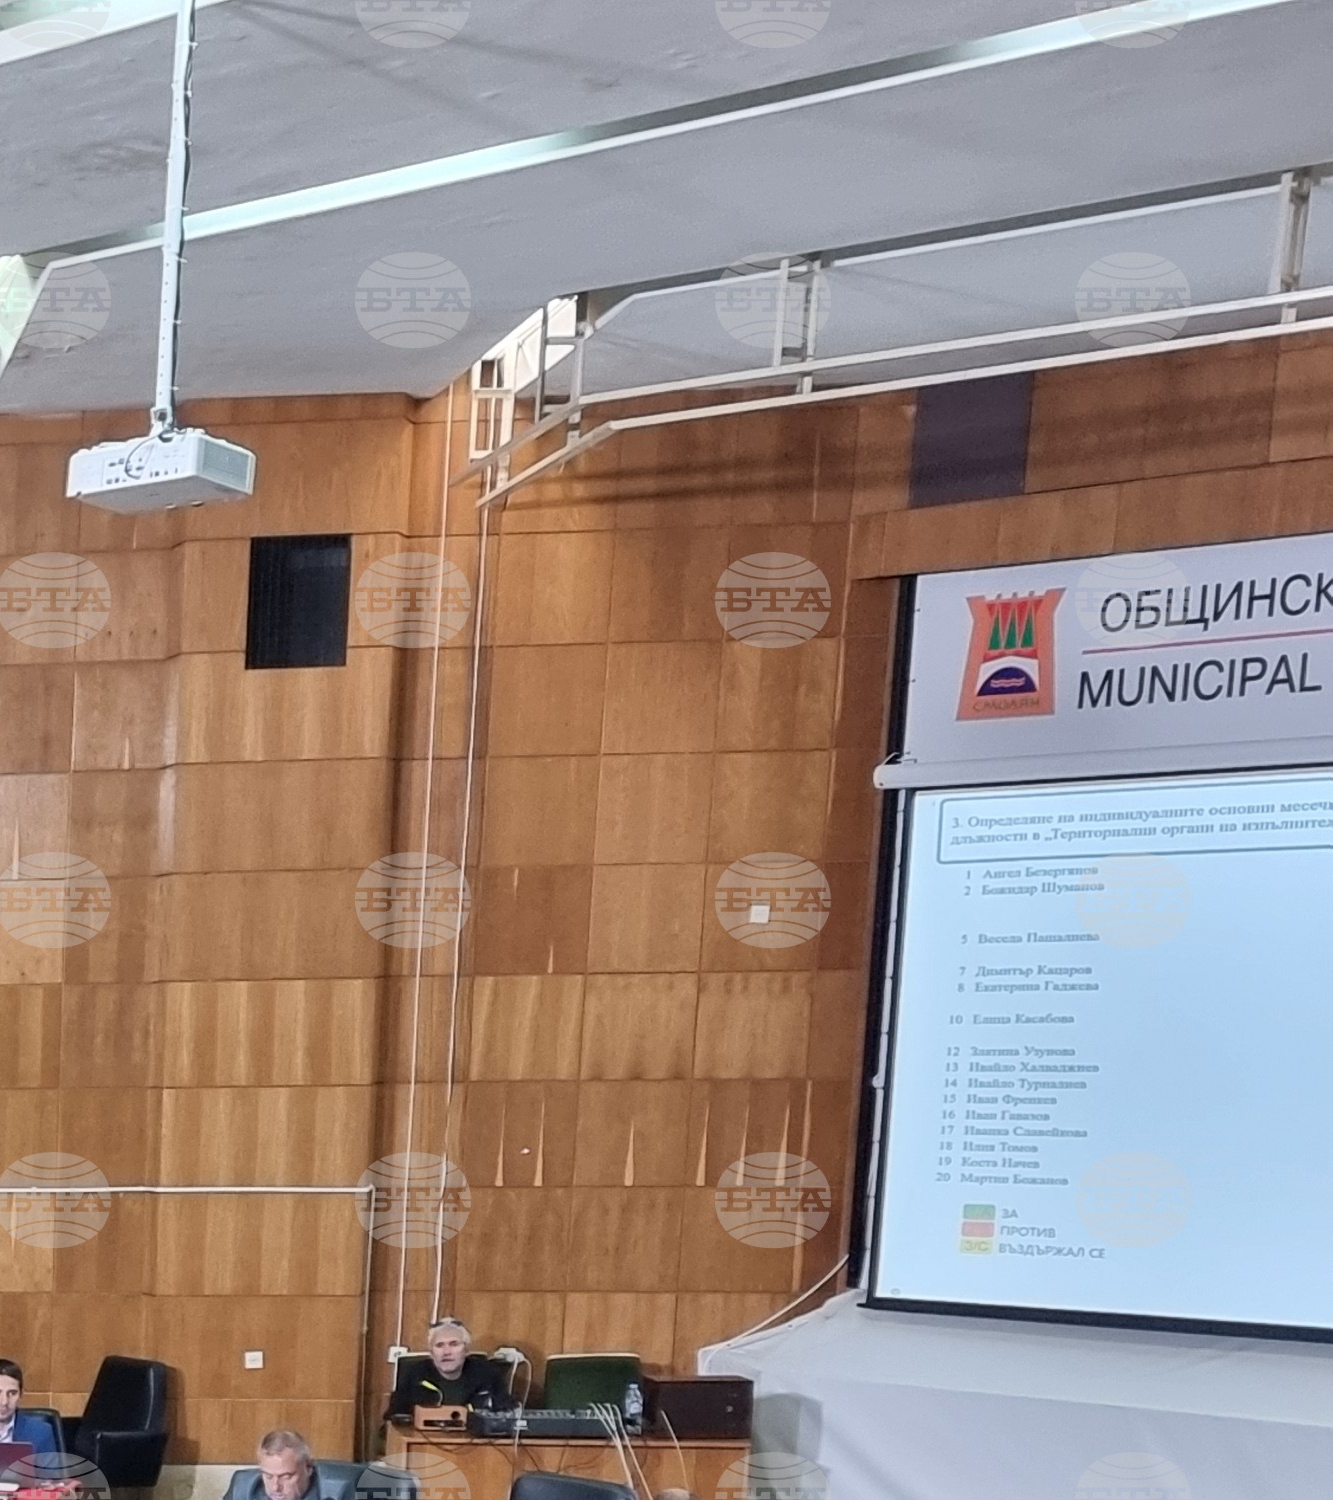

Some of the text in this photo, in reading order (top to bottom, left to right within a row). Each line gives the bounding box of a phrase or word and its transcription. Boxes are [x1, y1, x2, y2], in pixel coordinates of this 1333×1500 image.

[1100, 572, 1333, 632] ОБЩИНСК
[1077, 652, 1322, 710] MUNICIPAL
[982, 869, 1021, 880] Ангел
[949, 1015, 963, 1025] 10
[946, 1046, 960, 1057] 12
[946, 1062, 959, 1072] 13
[944, 1078, 958, 1088] 14
[943, 1094, 956, 1104] 15
[942, 1110, 956, 1120] 16
[940, 1125, 954, 1135] 17
[939, 1141, 953, 1151] 18
[938, 1156, 952, 1166] 19
[935, 1172, 951, 1182] 20
[1001, 1208, 1019, 1219] ЗА
[1000, 1225, 1056, 1238] ПРОТИВ
[998, 1243, 1106, 1259] ВЪЗДЪРЖАЛ СЕ
